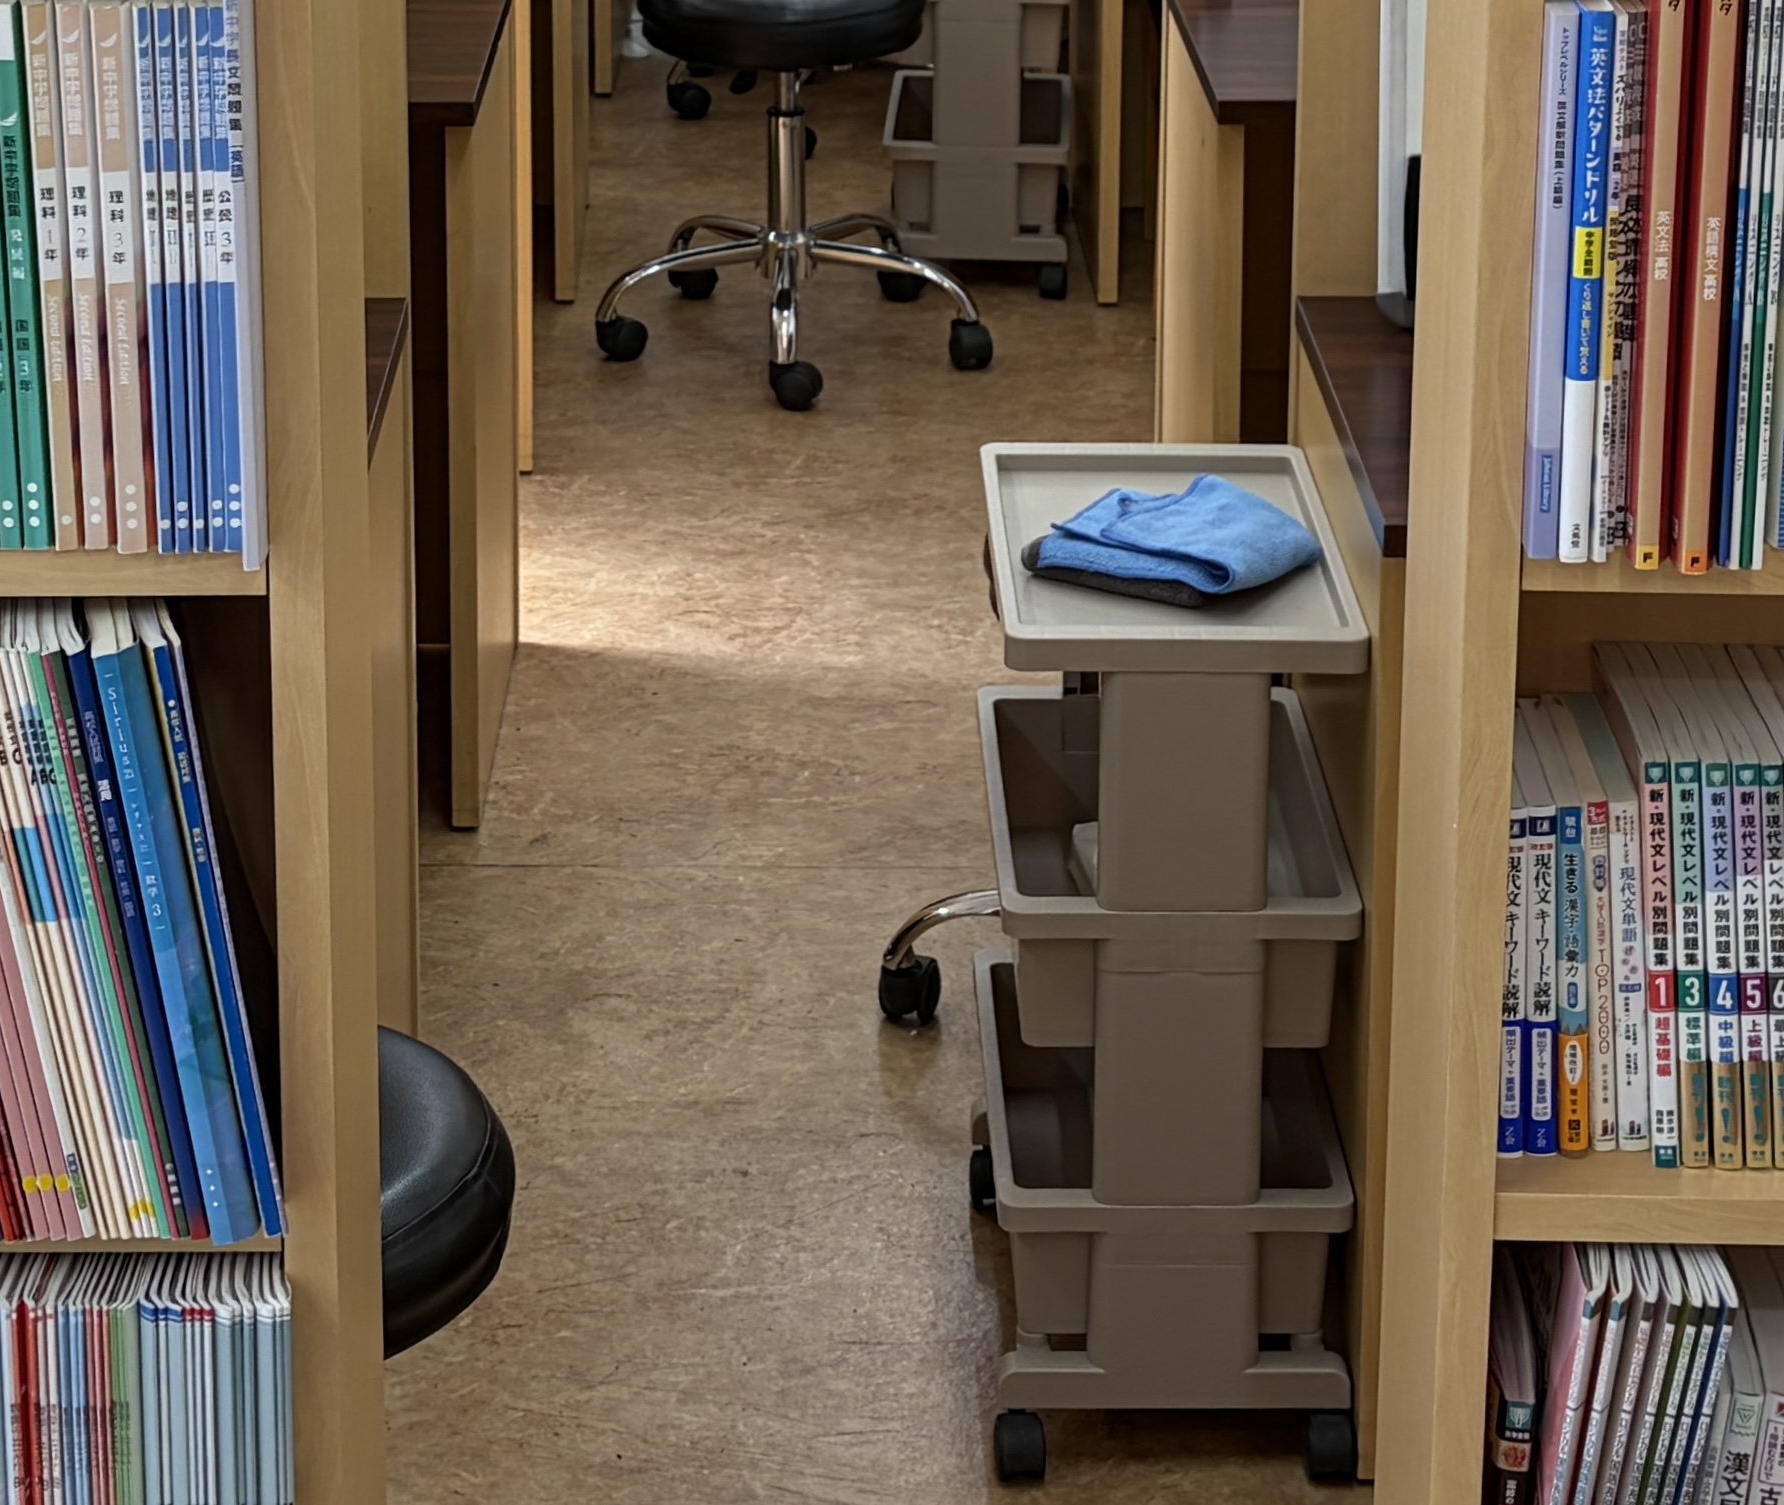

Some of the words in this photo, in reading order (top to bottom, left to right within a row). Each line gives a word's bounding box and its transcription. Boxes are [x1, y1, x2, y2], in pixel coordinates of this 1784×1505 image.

[1581, 48, 1610, 223] 英文法パターンドリル
[1563, 852, 1578, 893] 生きる
[1649, 788, 1670, 968] 新・現代文レベル別問題集
[1679, 788, 1699, 967] 新・現代文レベル別問題集
[1532, 909, 1551, 1017] キーワード読解
[1716, 978, 1733, 1008] 4
[1746, 975, 1761, 1004] 5
